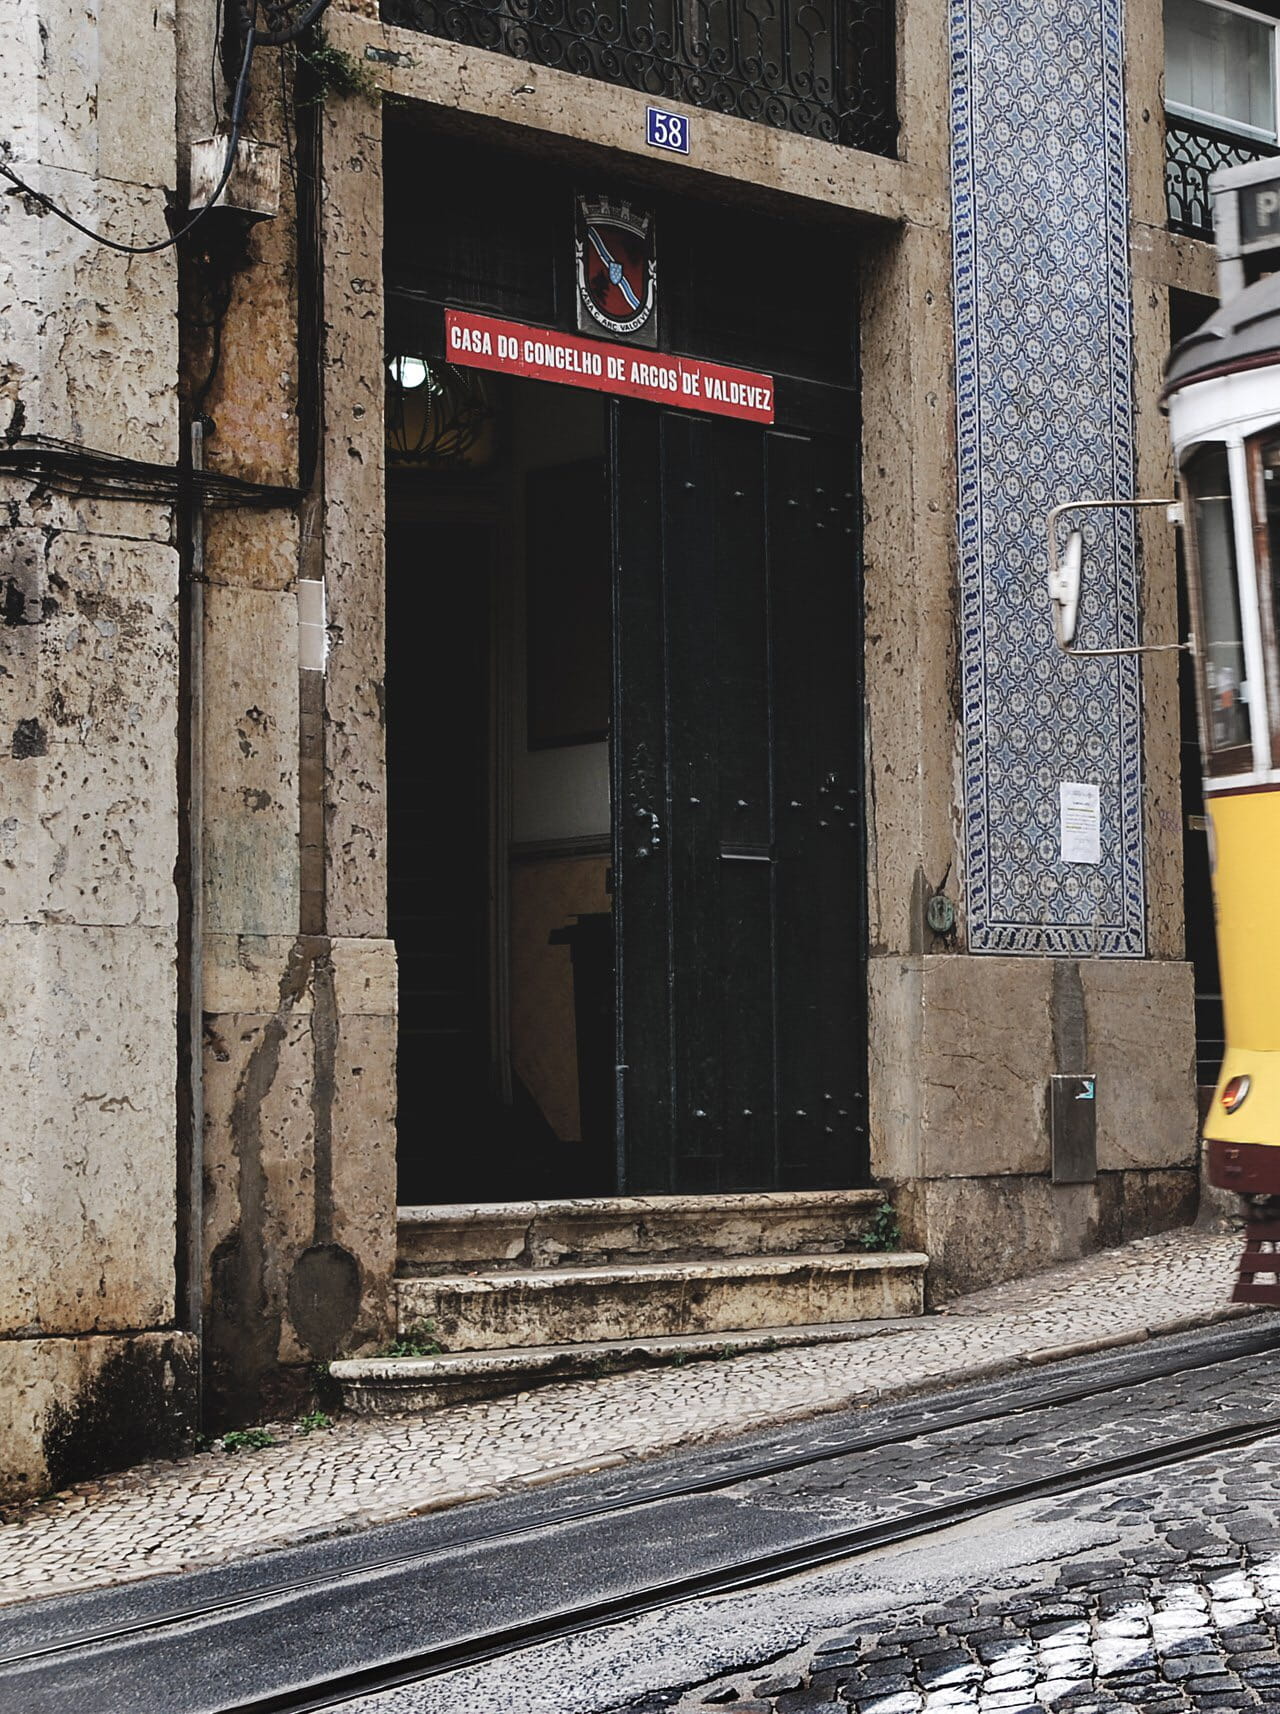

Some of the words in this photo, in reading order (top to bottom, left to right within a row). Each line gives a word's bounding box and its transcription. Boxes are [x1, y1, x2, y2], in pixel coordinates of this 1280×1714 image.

[654, 113, 682, 147] 58
[451, 326, 492, 356] CASA
[497, 335, 519, 360] DO
[524, 340, 602, 376] CONCELHO
[607, 356, 626, 381] DE
[631, 361, 678, 392] ARCOS
[682, 371, 700, 396] DE
[704, 376, 771, 411] VALDEVEZ
